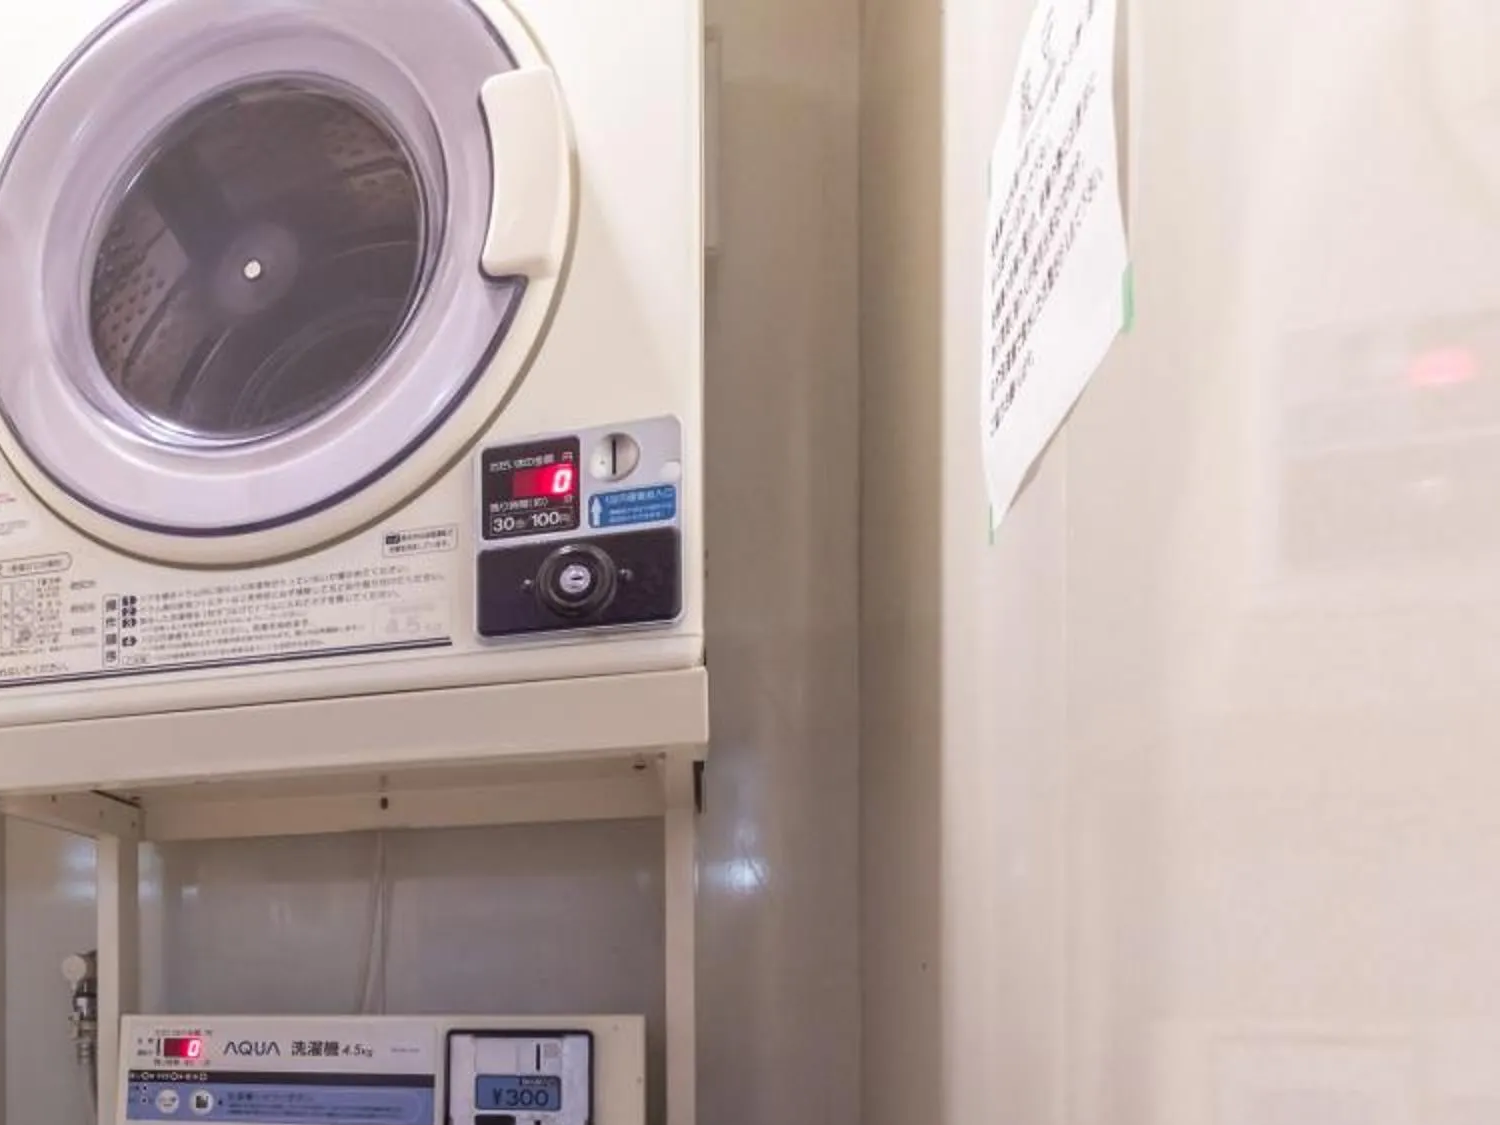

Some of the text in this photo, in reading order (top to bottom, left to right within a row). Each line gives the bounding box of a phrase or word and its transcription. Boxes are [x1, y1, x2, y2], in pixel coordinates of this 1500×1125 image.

[552, 469, 573, 494] 0
[185, 1039, 201, 1057] 0
[223, 1040, 281, 1057] AQUA
[291, 1040, 339, 1057] 洗濯機
[492, 1088, 549, 1107] ¥300
